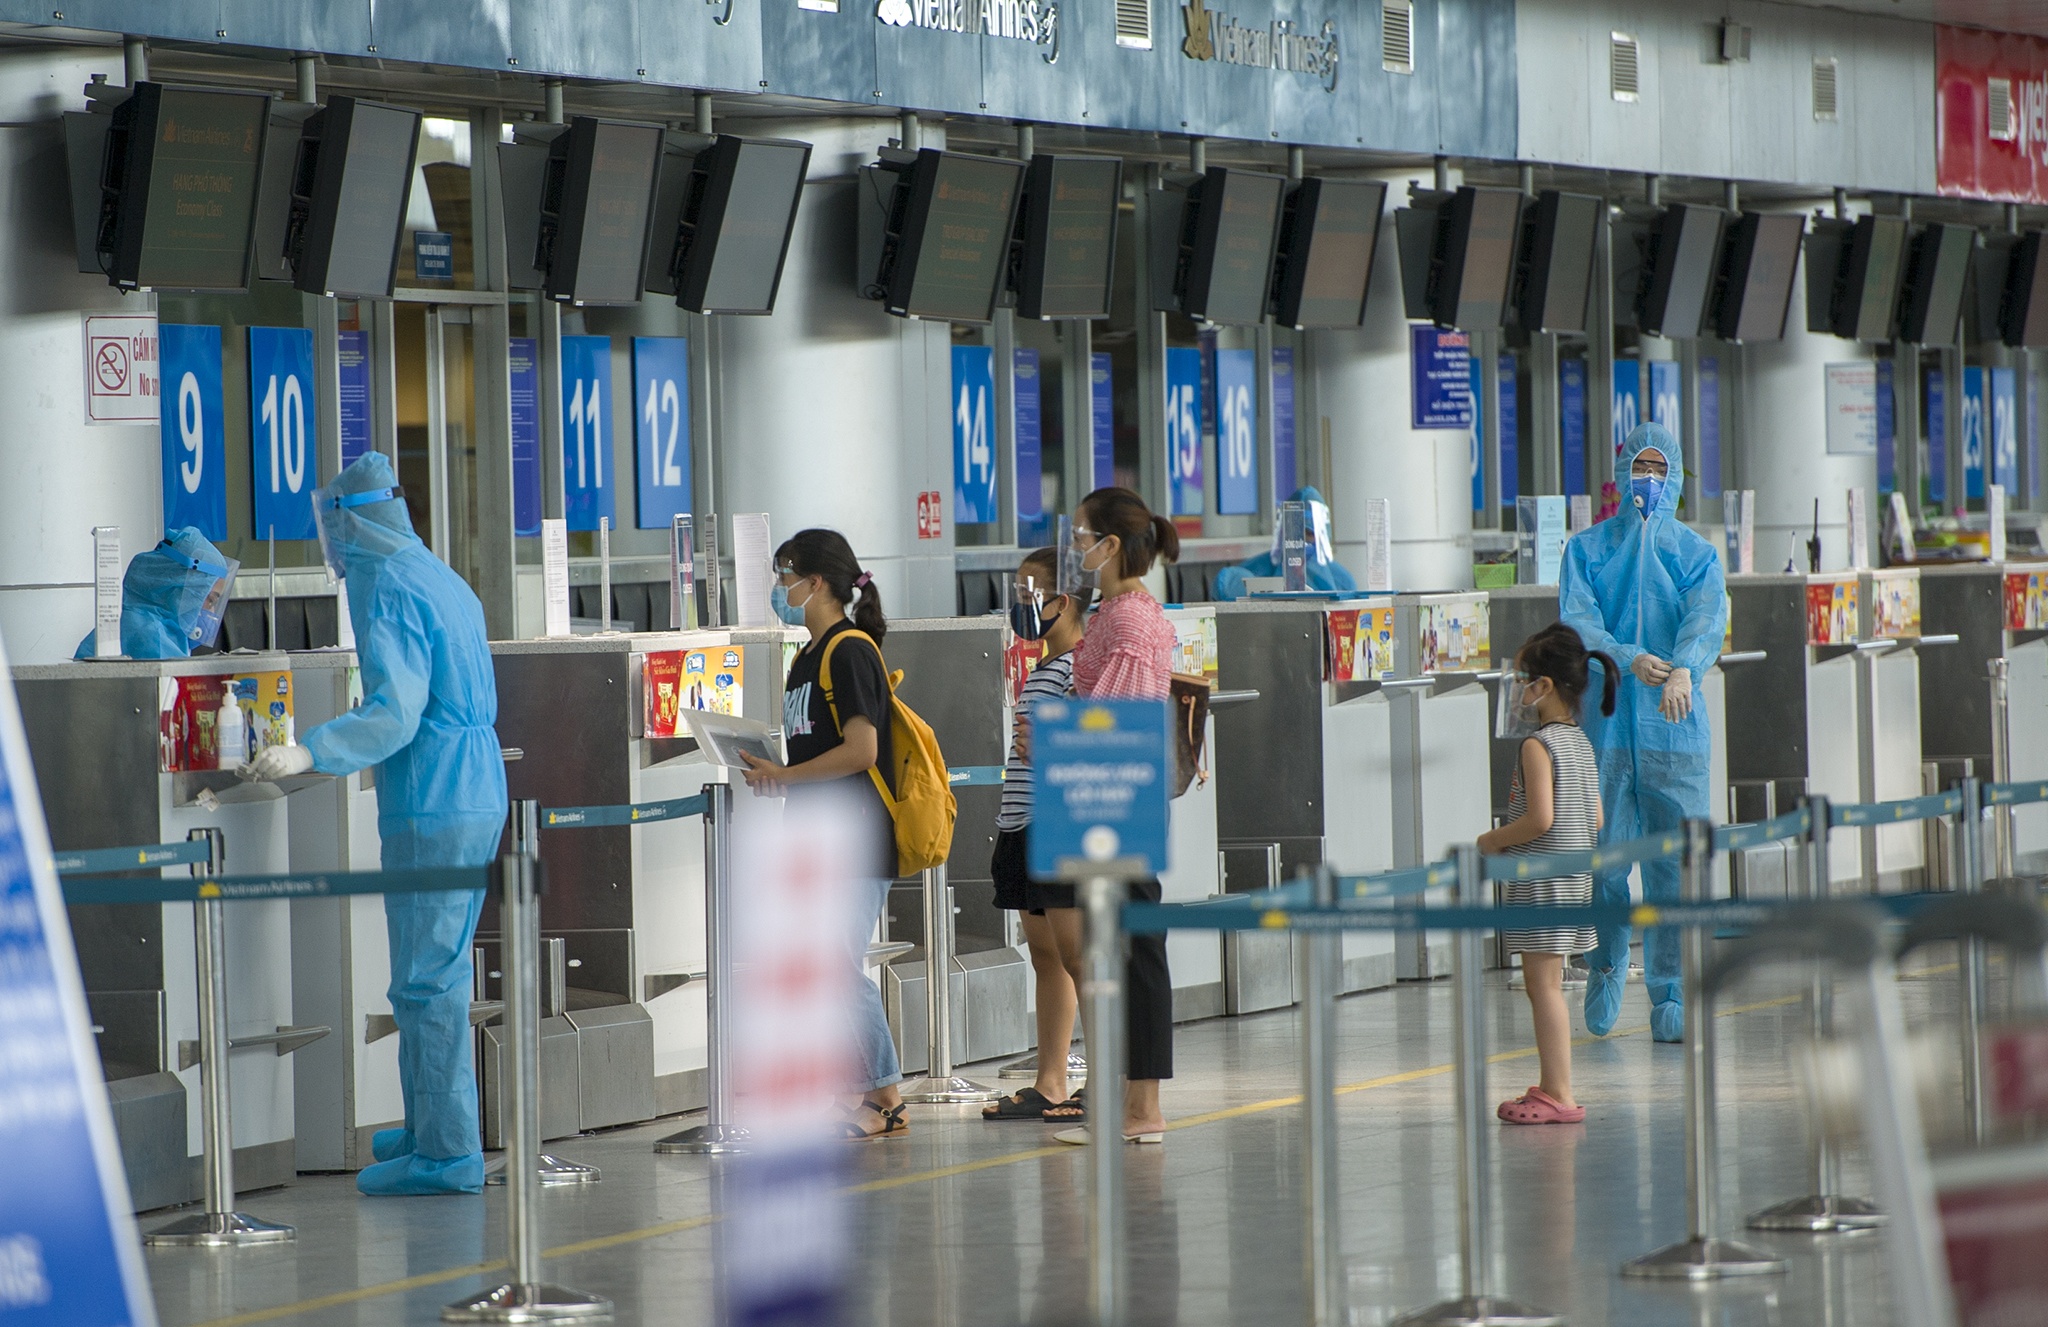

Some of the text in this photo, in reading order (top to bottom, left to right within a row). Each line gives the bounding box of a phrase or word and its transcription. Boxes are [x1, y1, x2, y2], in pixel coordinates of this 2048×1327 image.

[1211, 11, 1321, 74] Vietnam Airlines
[139, 372, 151, 397] No
[178, 371, 204, 494] 9
[262, 374, 305, 494] 10
[569, 378, 602, 488] 11
[645, 379, 681, 486] 12
[957, 384, 990, 484] 14
[1168, 384, 1196, 478] 15
[1222, 384, 1251, 478] 16
